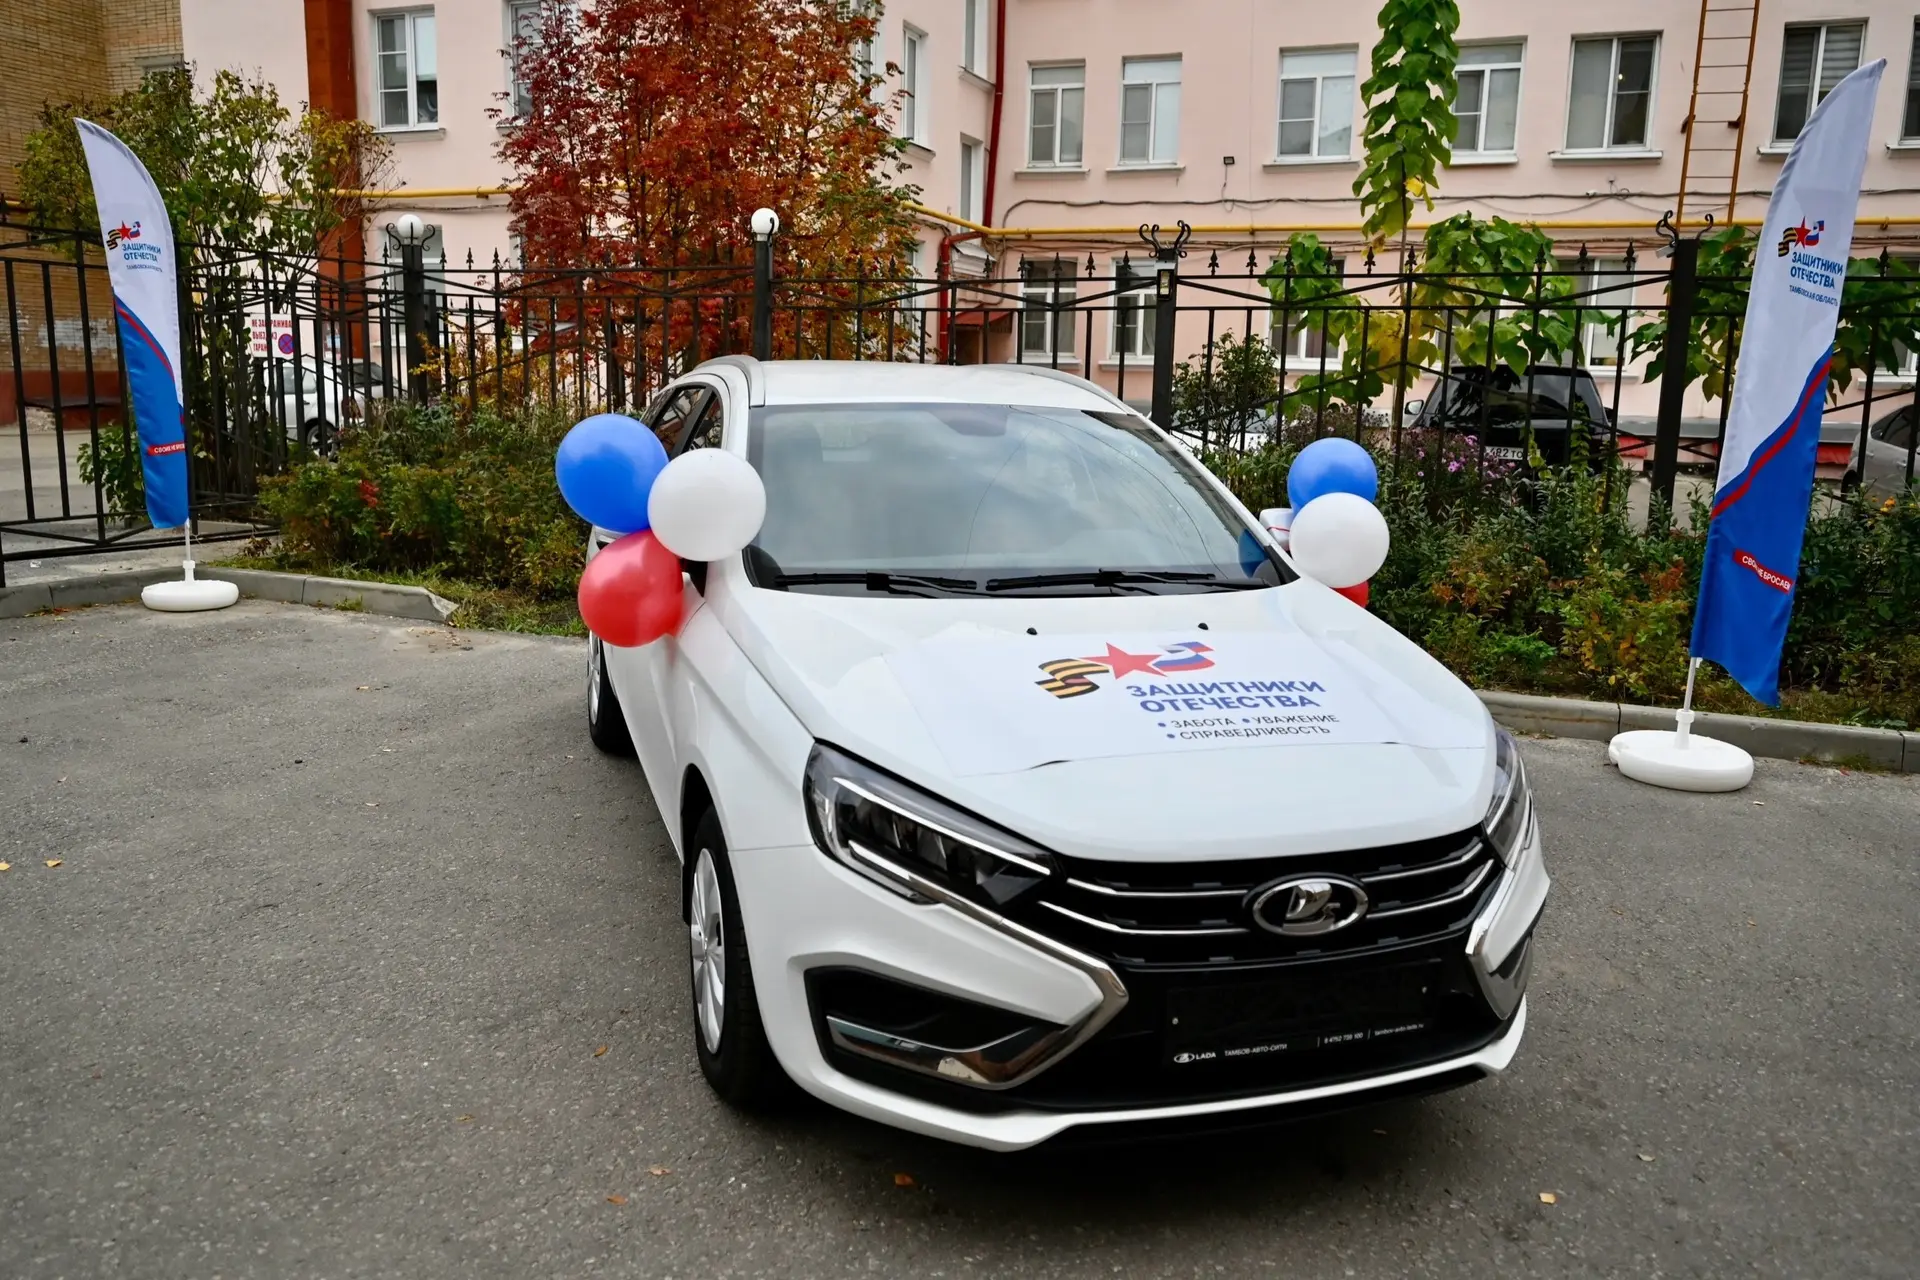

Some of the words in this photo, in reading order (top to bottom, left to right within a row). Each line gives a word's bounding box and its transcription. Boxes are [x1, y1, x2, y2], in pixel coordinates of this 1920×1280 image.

[122, 243, 161, 255] ЗАЩИТНИКИ
[124, 252, 158, 262] ОТЕЧЕСТВА
[1791, 252, 1844, 276] ЗАЩИТНИКИ
[1790, 266, 1836, 289] ОТЕЧЕСТВА
[1126, 681, 1326, 697] ЗАЩИТНИКИ
[1139, 695, 1321, 713] ОТЕЧЕСТВА
[1171, 717, 1236, 729] ЗАБОТА
[1251, 714, 1340, 724] УВАЖЕНИЕ
[1180, 725, 1331, 741] СПРАВЕДЛИВОСТЬ
[1195, 1051, 1217, 1060] LADA
